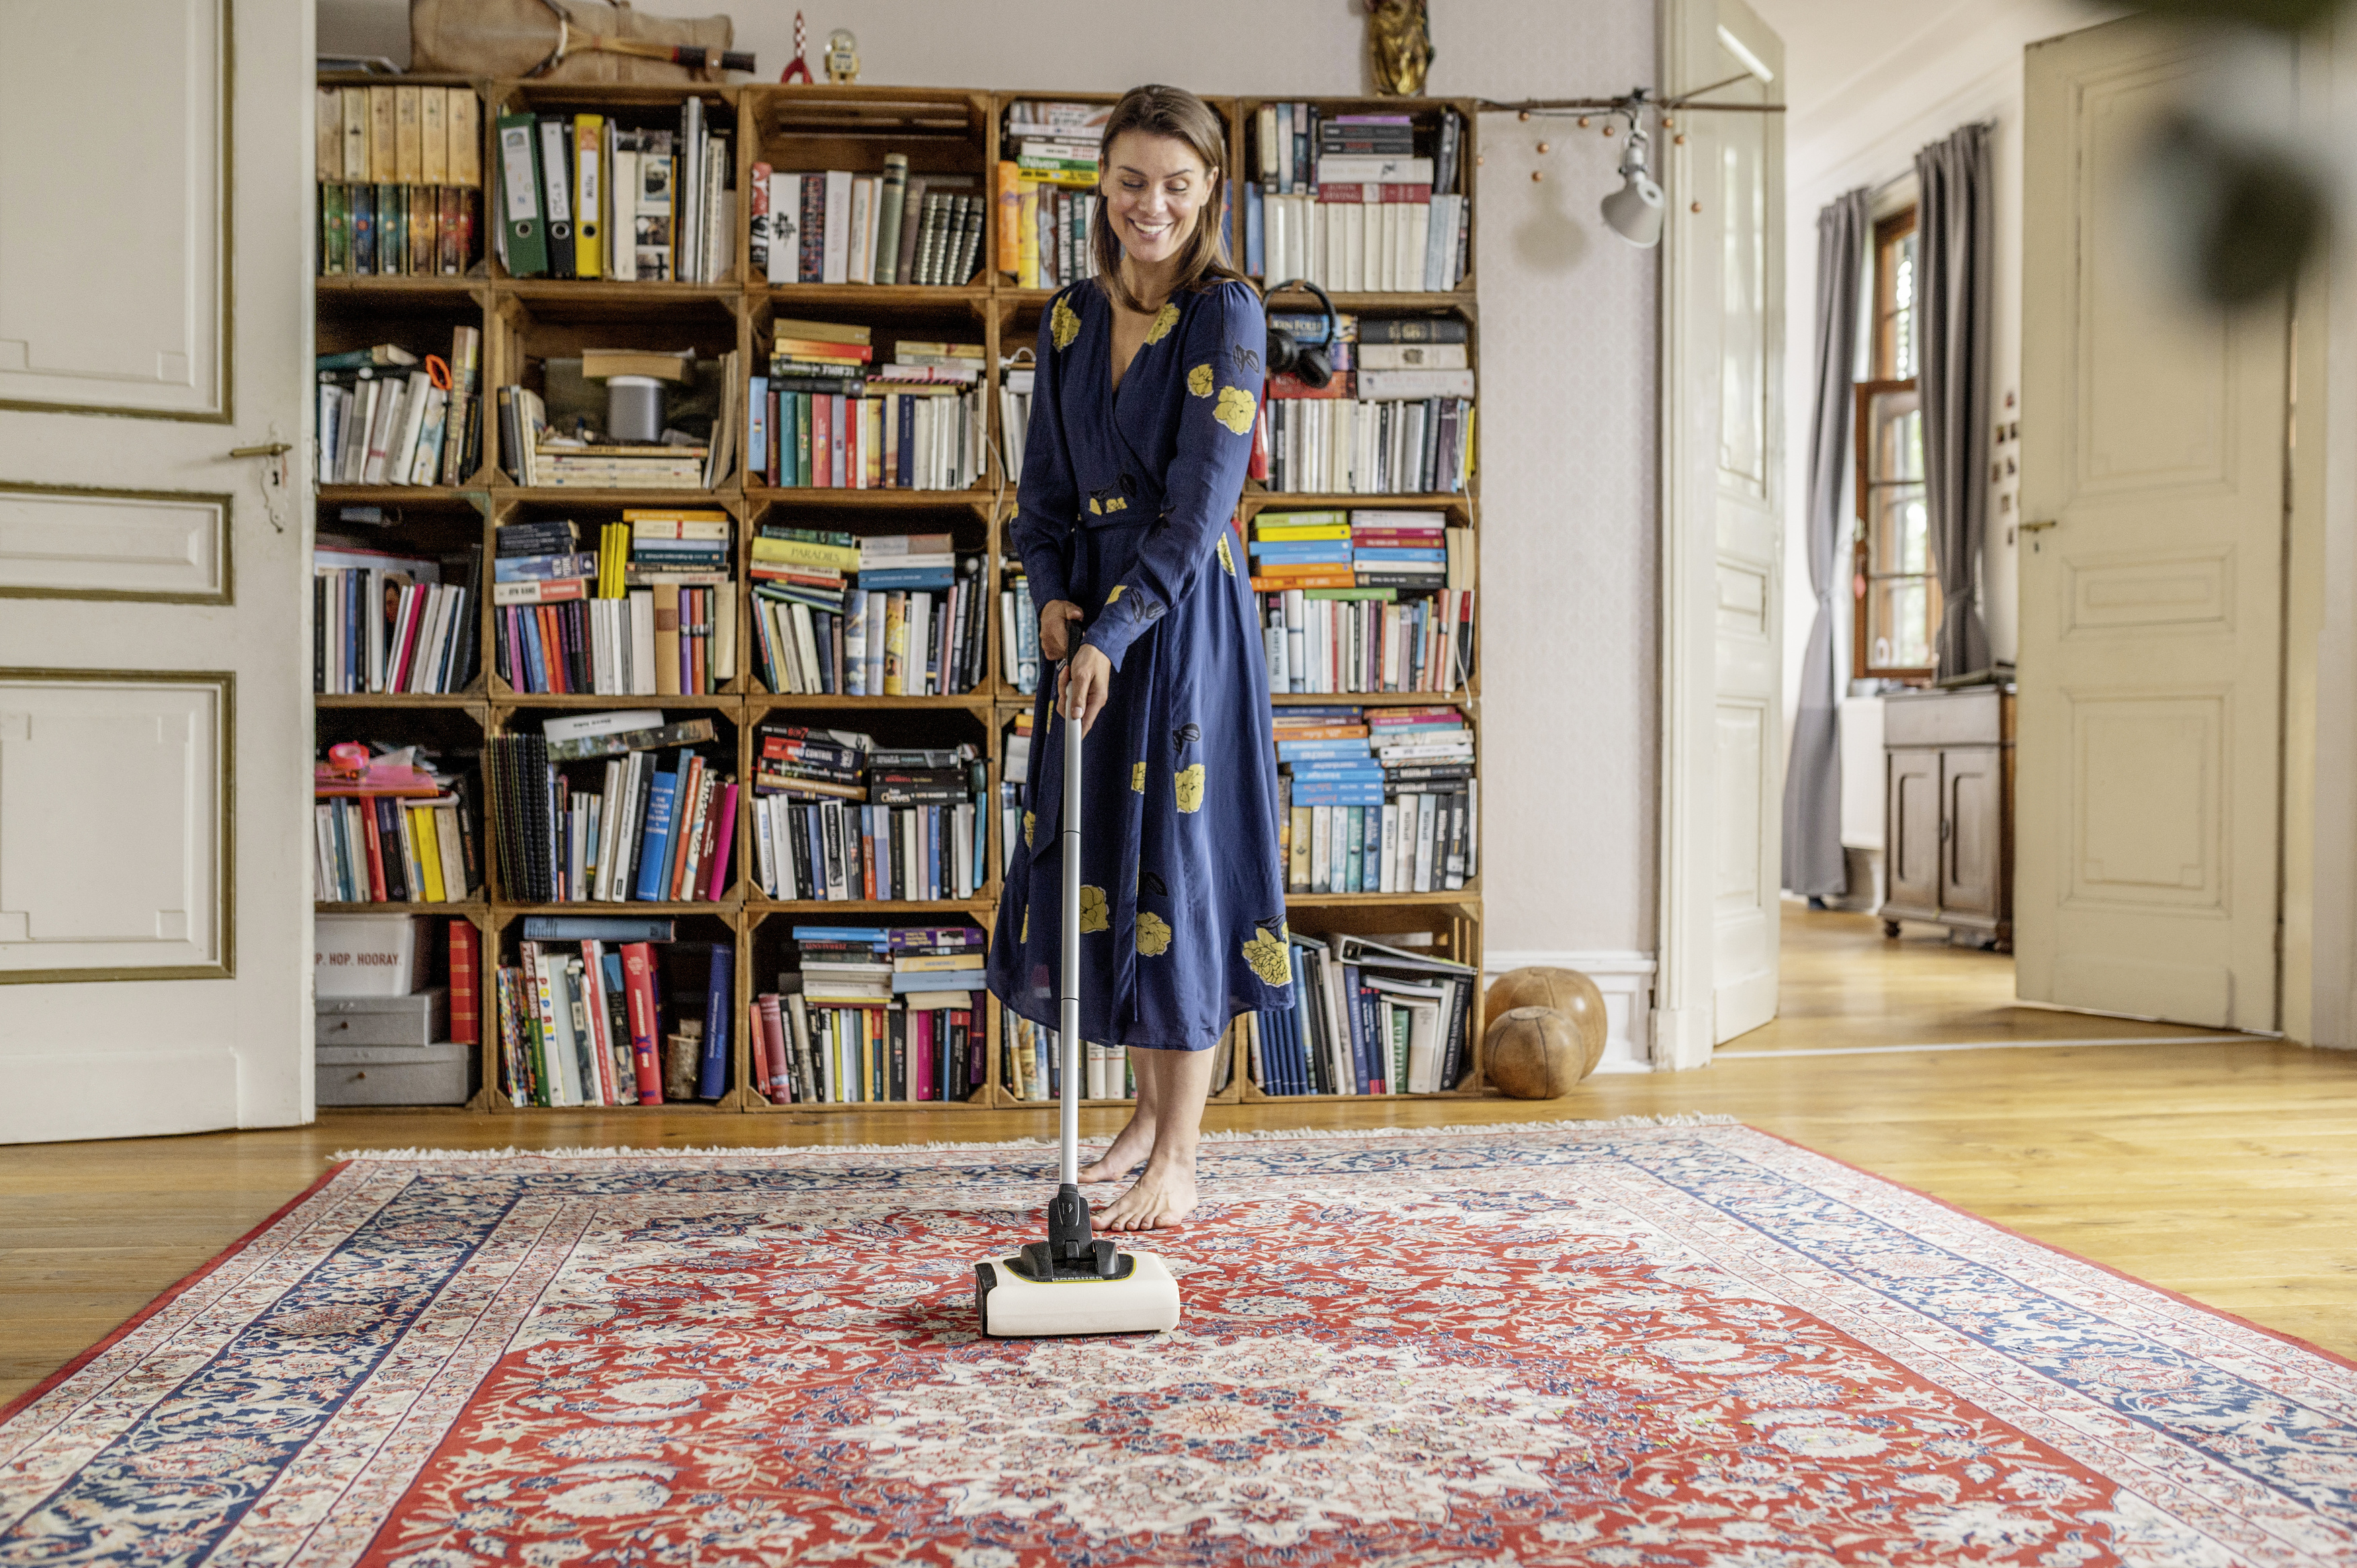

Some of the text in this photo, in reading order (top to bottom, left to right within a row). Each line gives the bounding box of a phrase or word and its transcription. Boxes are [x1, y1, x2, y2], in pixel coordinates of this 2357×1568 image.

[791, 547, 841, 563] PARADIES
[329, 953, 354, 966] HOP.
[357, 953, 402, 966] HOORAY.
[538, 977, 555, 1042] POP ART
[635, 1035, 652, 1055] XX
